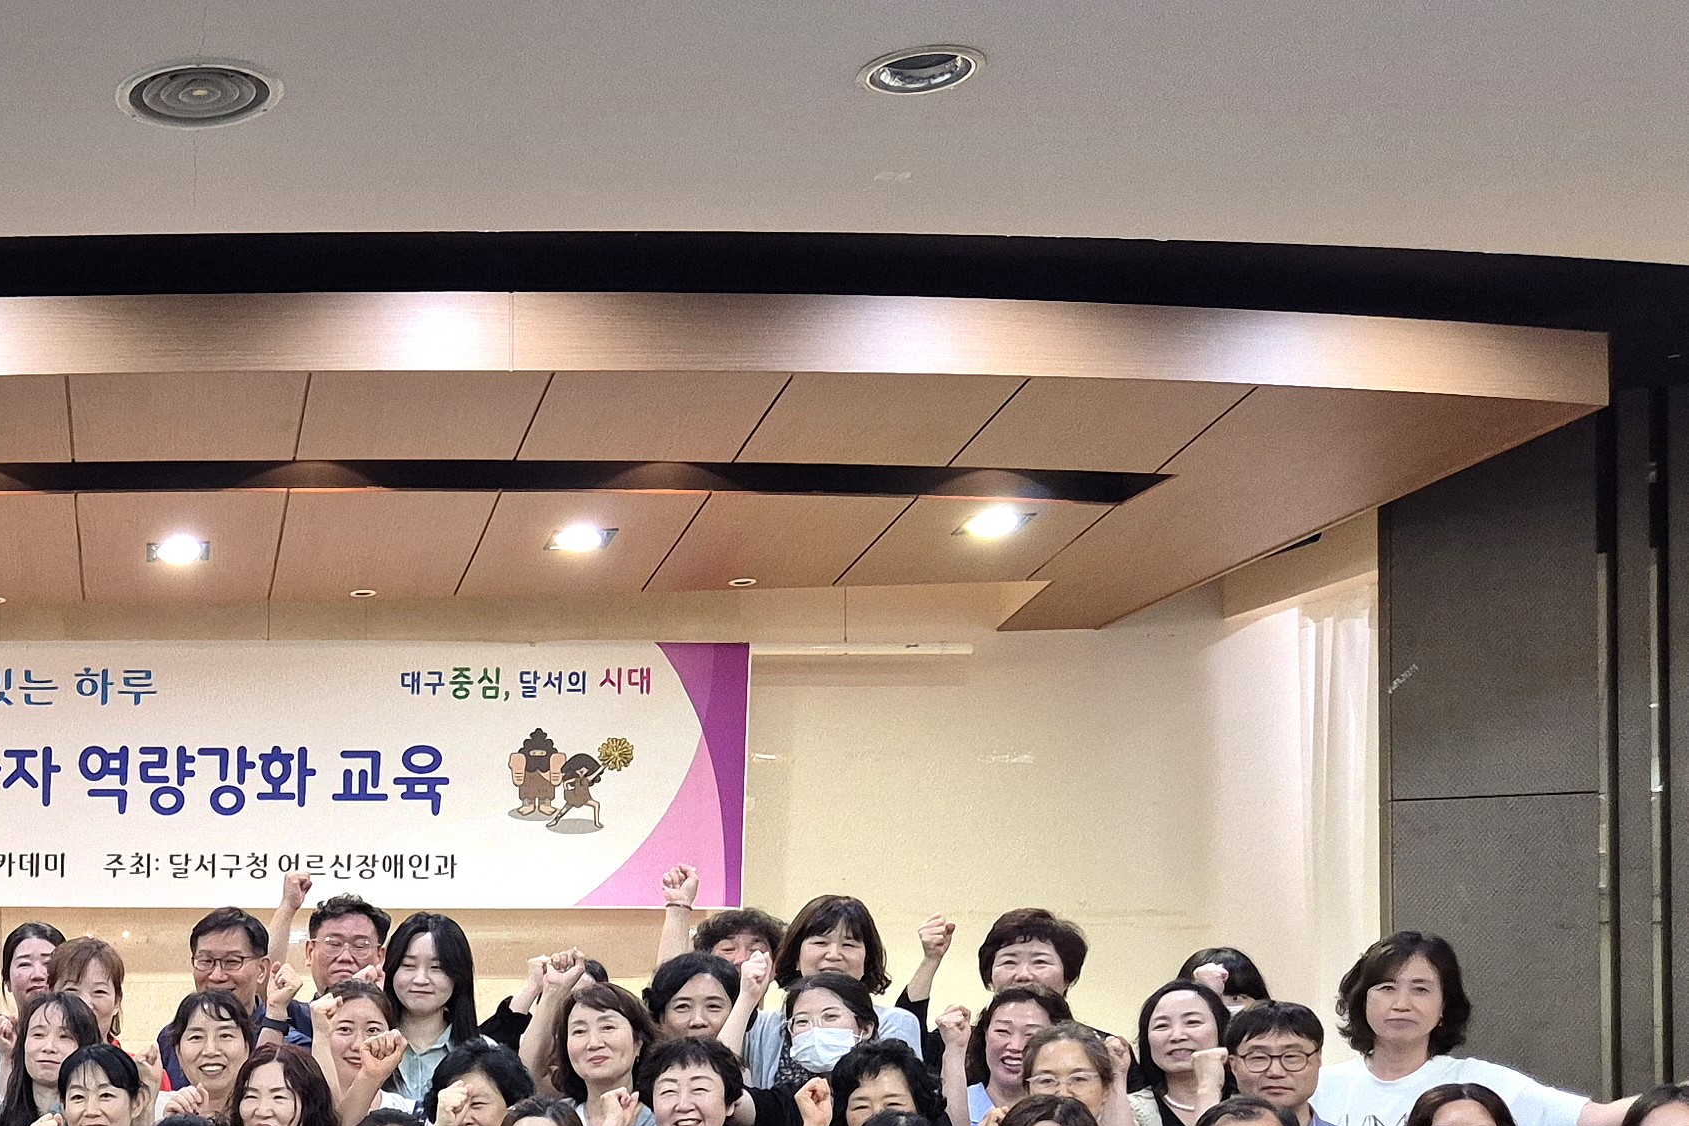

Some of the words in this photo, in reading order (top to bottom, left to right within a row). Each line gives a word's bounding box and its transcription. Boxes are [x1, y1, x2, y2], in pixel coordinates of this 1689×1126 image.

[73, 666, 158, 706] 하루
[518, 669, 588, 699] 달서의
[598, 665, 652, 695] 시대
[77, 744, 317, 816] 역량강화
[331, 744, 451, 817] 교육
[103, 852, 160, 879] 주최:
[169, 852, 268, 880] 달서구청
[277, 852, 458, 880] 어르신장애인과
